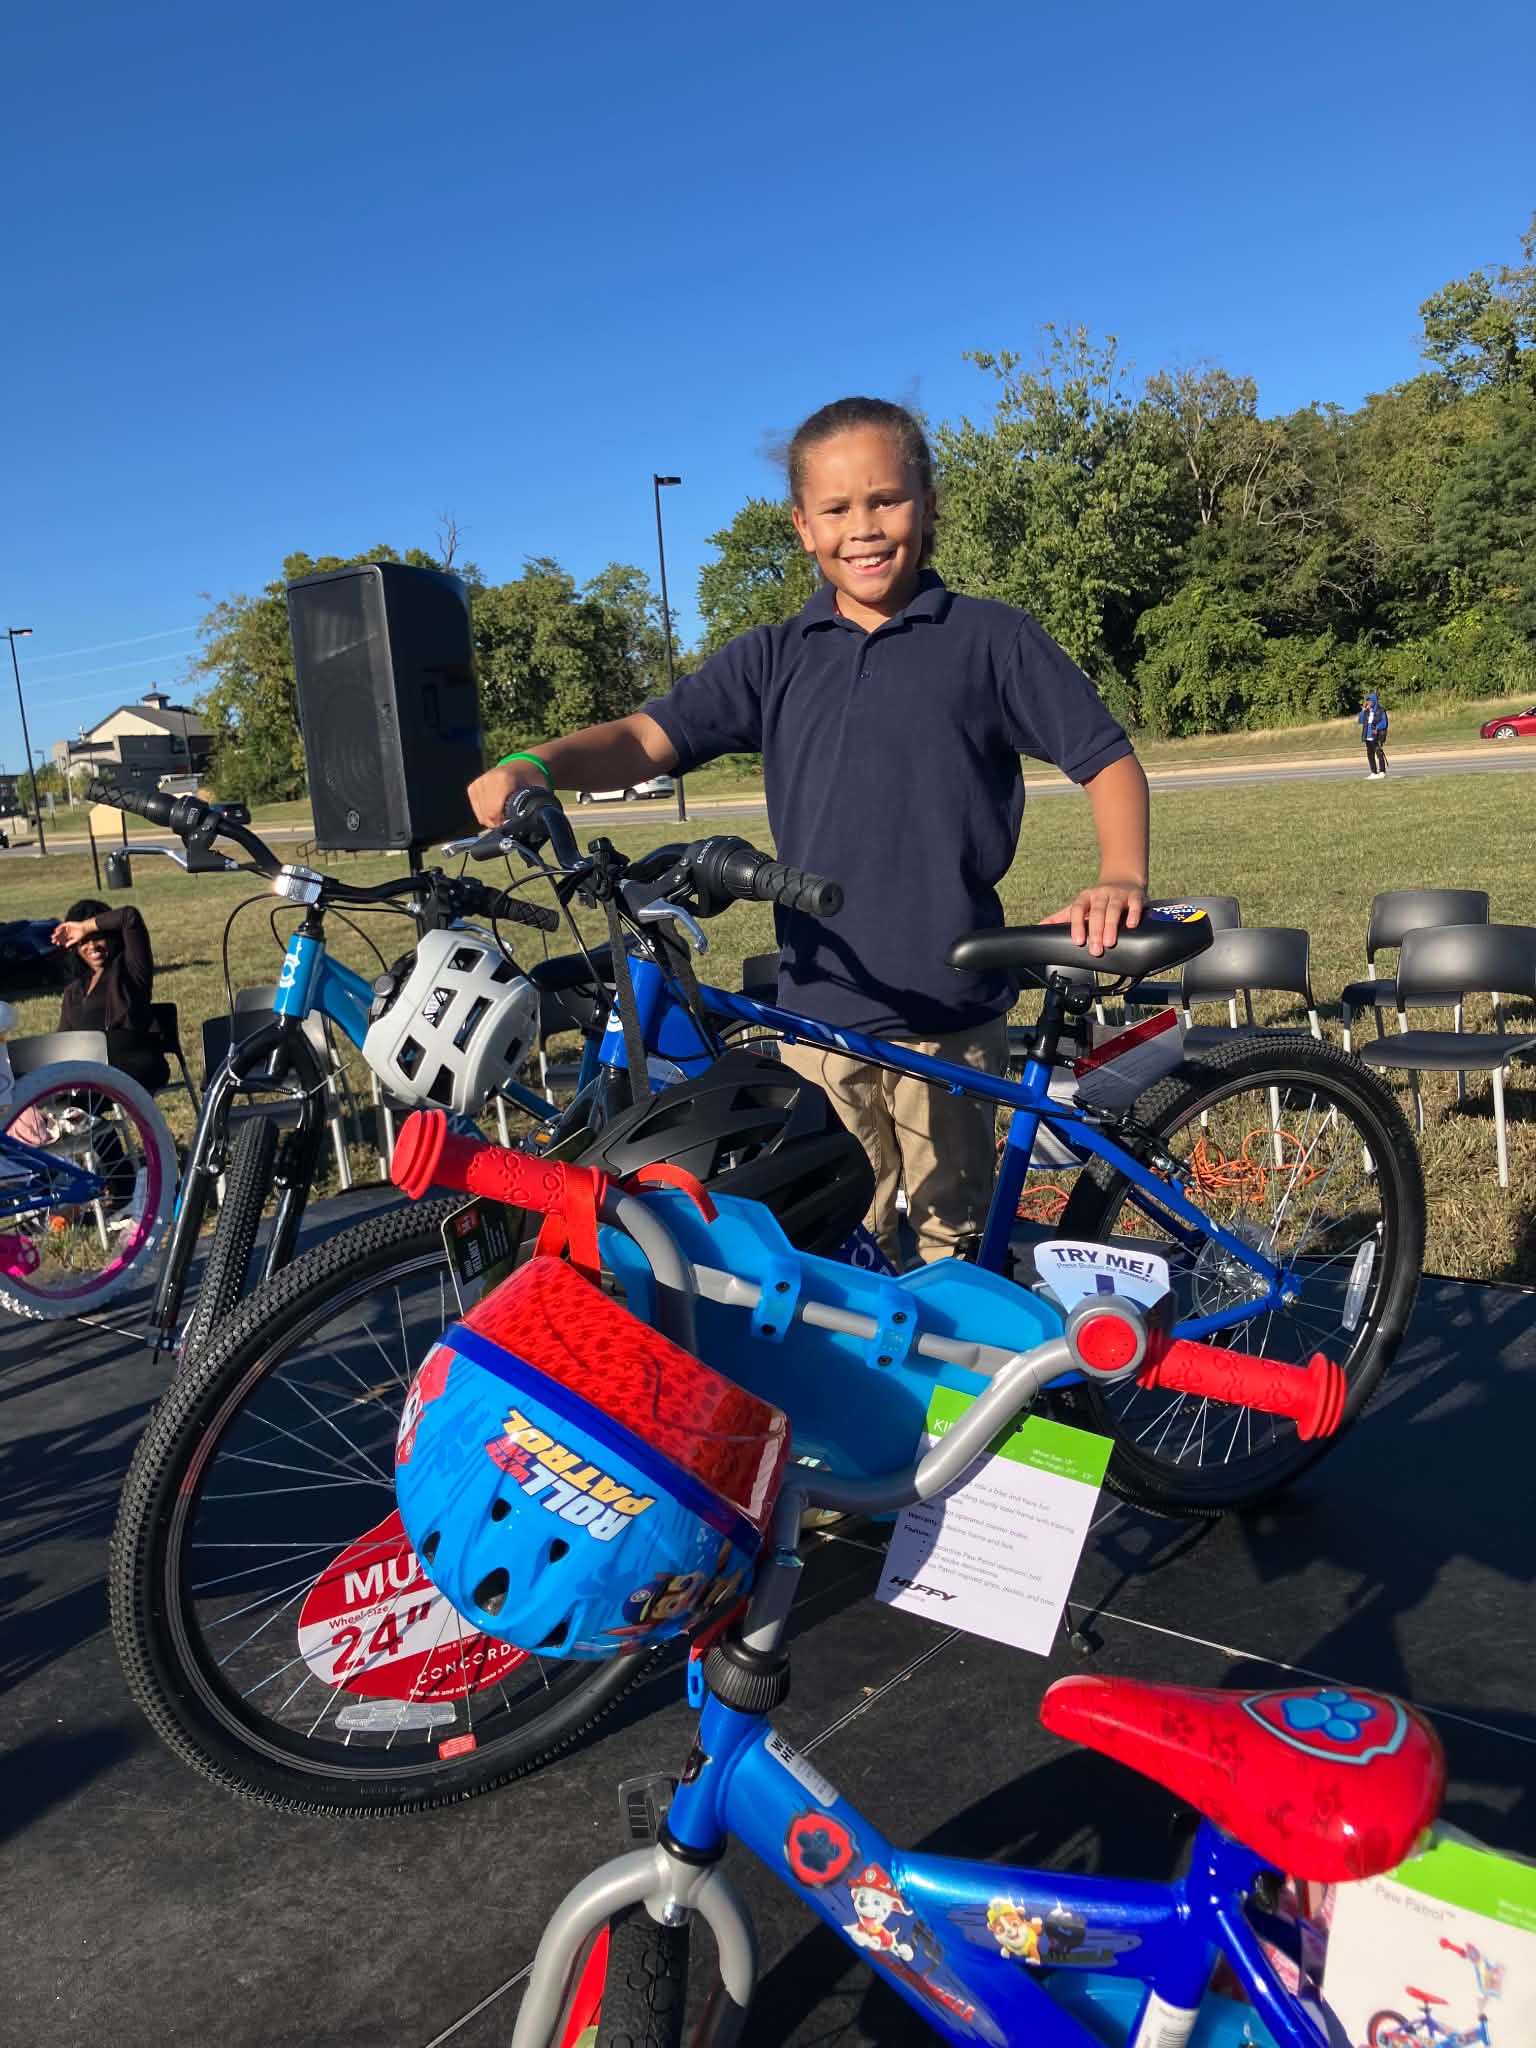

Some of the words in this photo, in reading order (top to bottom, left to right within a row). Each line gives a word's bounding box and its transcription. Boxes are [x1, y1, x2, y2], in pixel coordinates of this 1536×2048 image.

[1051, 1248, 1098, 1263] TRY
[1106, 1253, 1154, 1278] ME!
[503, 1410, 657, 1516] PATROL
[521, 1463, 633, 1541] ROLL
[343, 1552, 431, 1605] MU
[889, 1576, 958, 1601] HUFFY
[328, 1611, 364, 1629] Wheel
[331, 1601, 433, 1676] 24"
[417, 1643, 511, 1684] CONCORD
[1374, 1882, 1400, 1905] Paw
